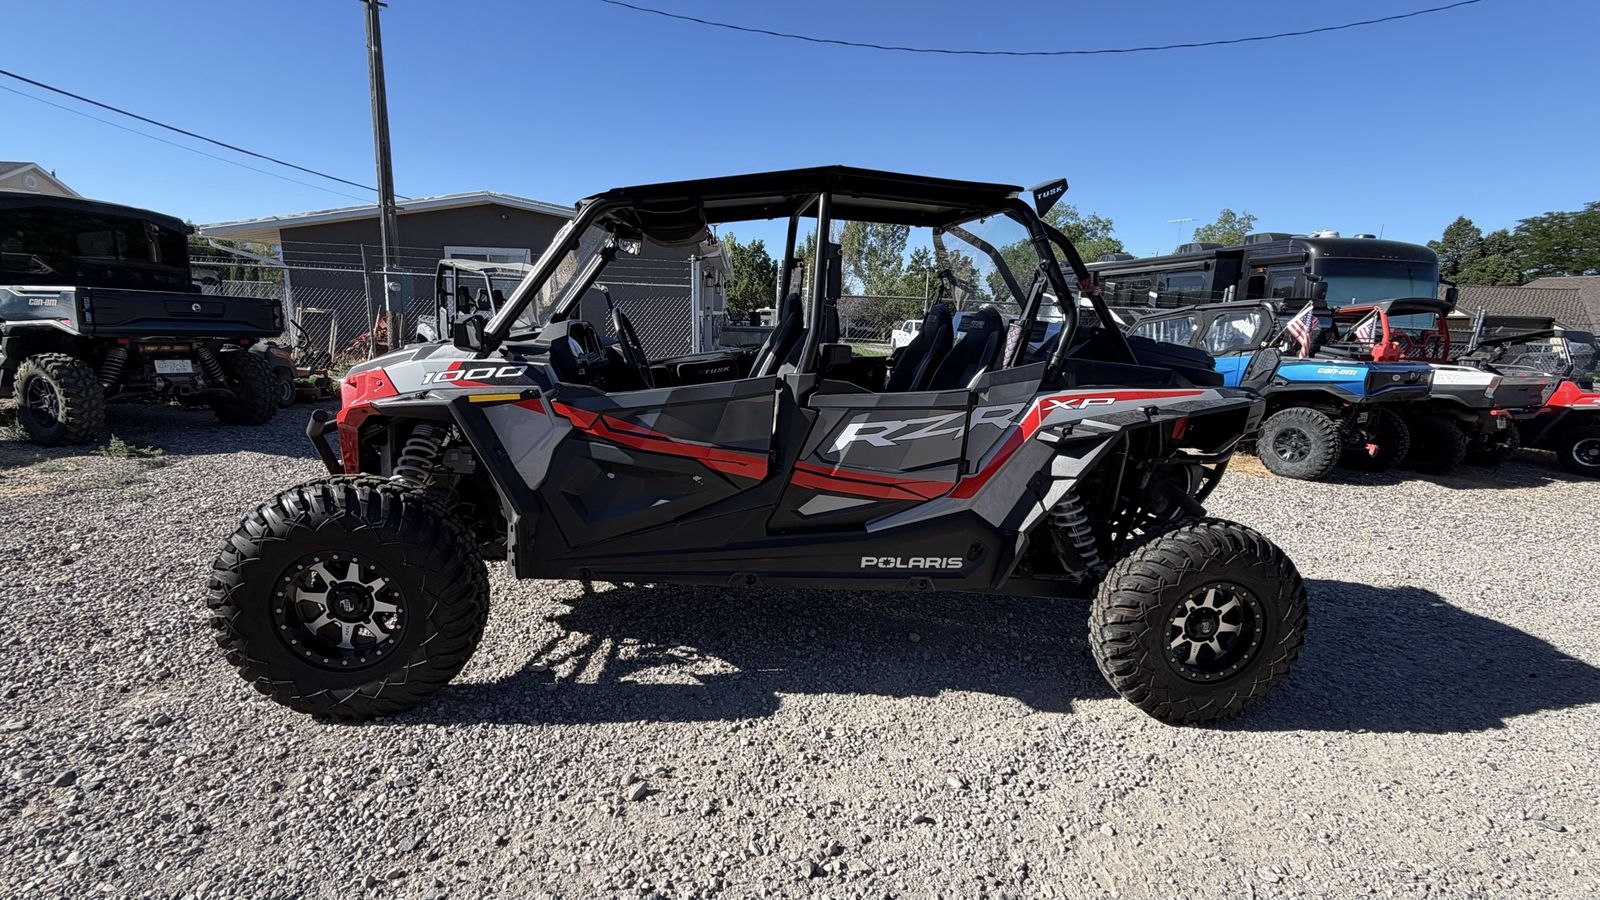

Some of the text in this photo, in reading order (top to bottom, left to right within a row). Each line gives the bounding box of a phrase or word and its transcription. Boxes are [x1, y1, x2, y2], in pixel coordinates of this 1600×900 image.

[1037, 185, 1063, 199] TUSK
[29, 298, 57, 306] can-am
[422, 365, 528, 385] 1000
[704, 366, 730, 374] TUSK
[1317, 367, 1358, 376] can-am
[1041, 398, 1116, 411] XP
[826, 402, 1028, 454] RZR
[861, 557, 963, 569] POLARIS
